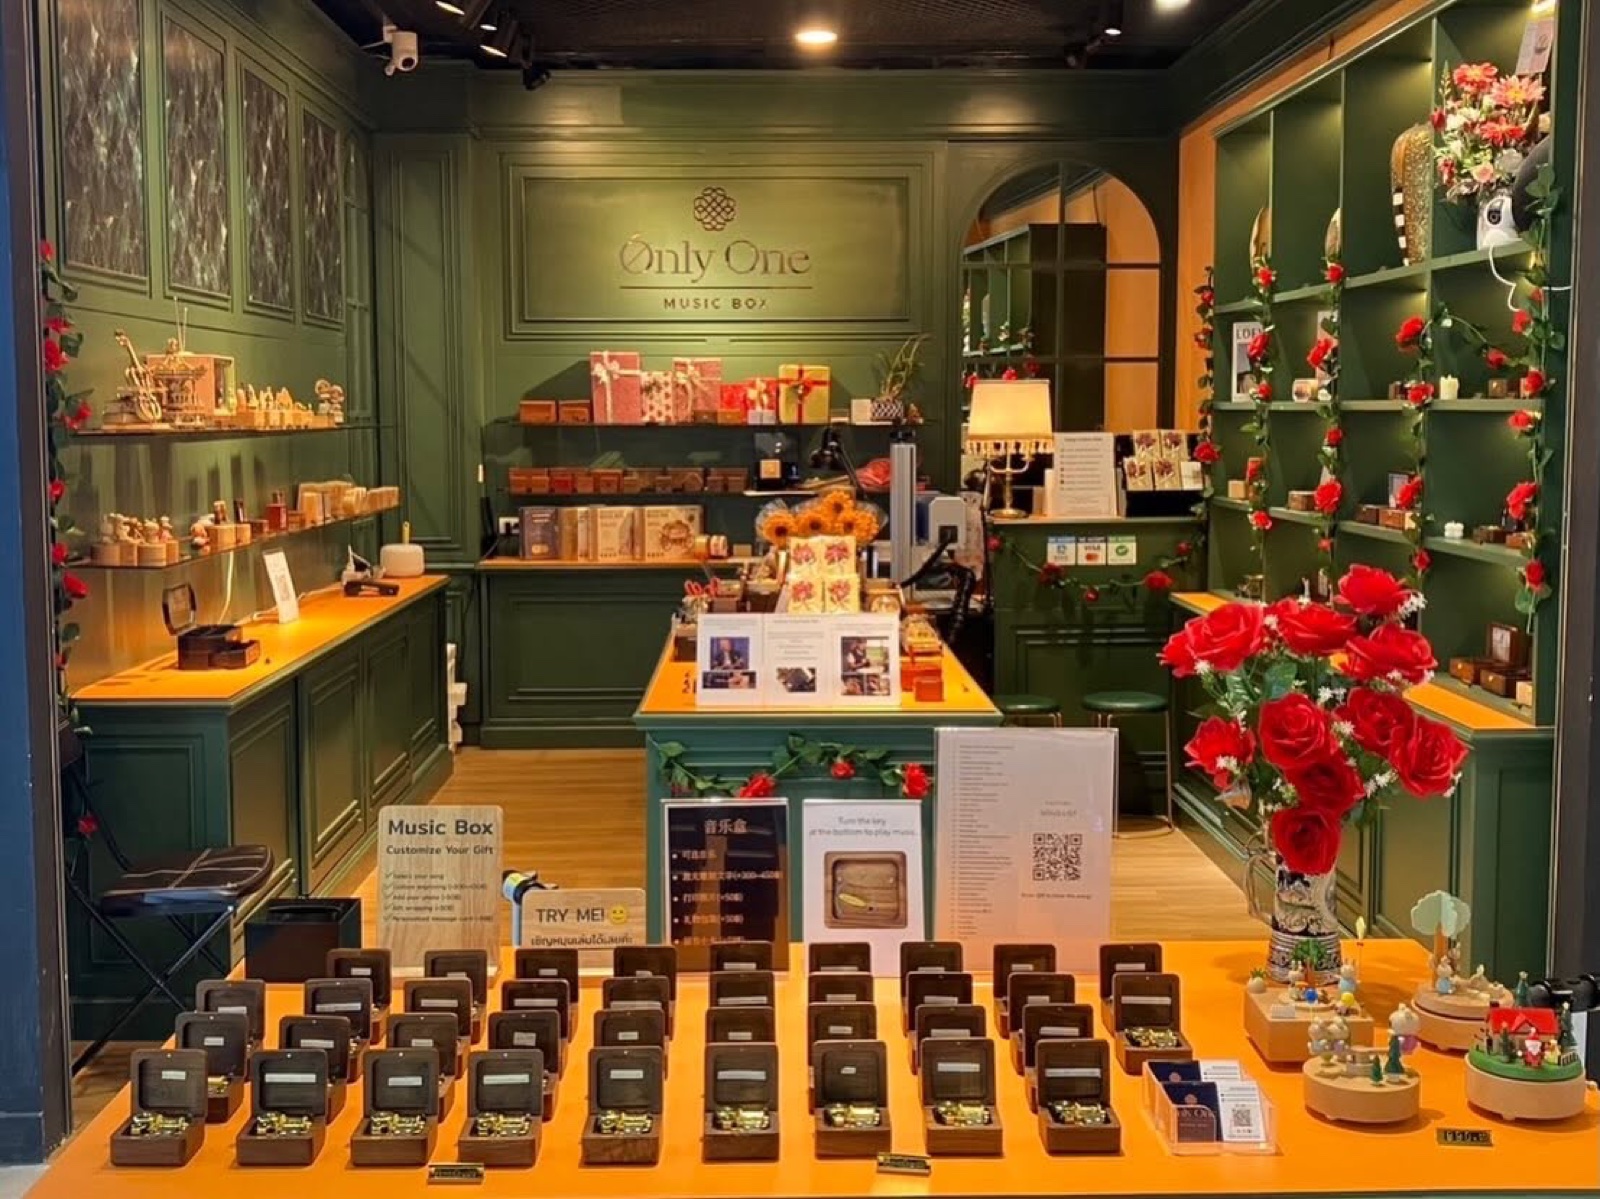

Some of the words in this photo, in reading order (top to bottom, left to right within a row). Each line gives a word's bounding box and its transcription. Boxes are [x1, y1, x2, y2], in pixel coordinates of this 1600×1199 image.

[725, 239, 811, 274] One
[663, 298, 721, 309] MUSIC
[732, 298, 768, 309] BOX
[388, 819, 446, 835] Music
[454, 820, 494, 835] Box
[704, 818, 747, 834] 音乐盒
[386, 845, 442, 855] Customize
[446, 845, 469, 855] Your
[473, 845, 494, 855] Gift
[537, 908, 569, 922] TRY
[576, 908, 605, 922] ME!
